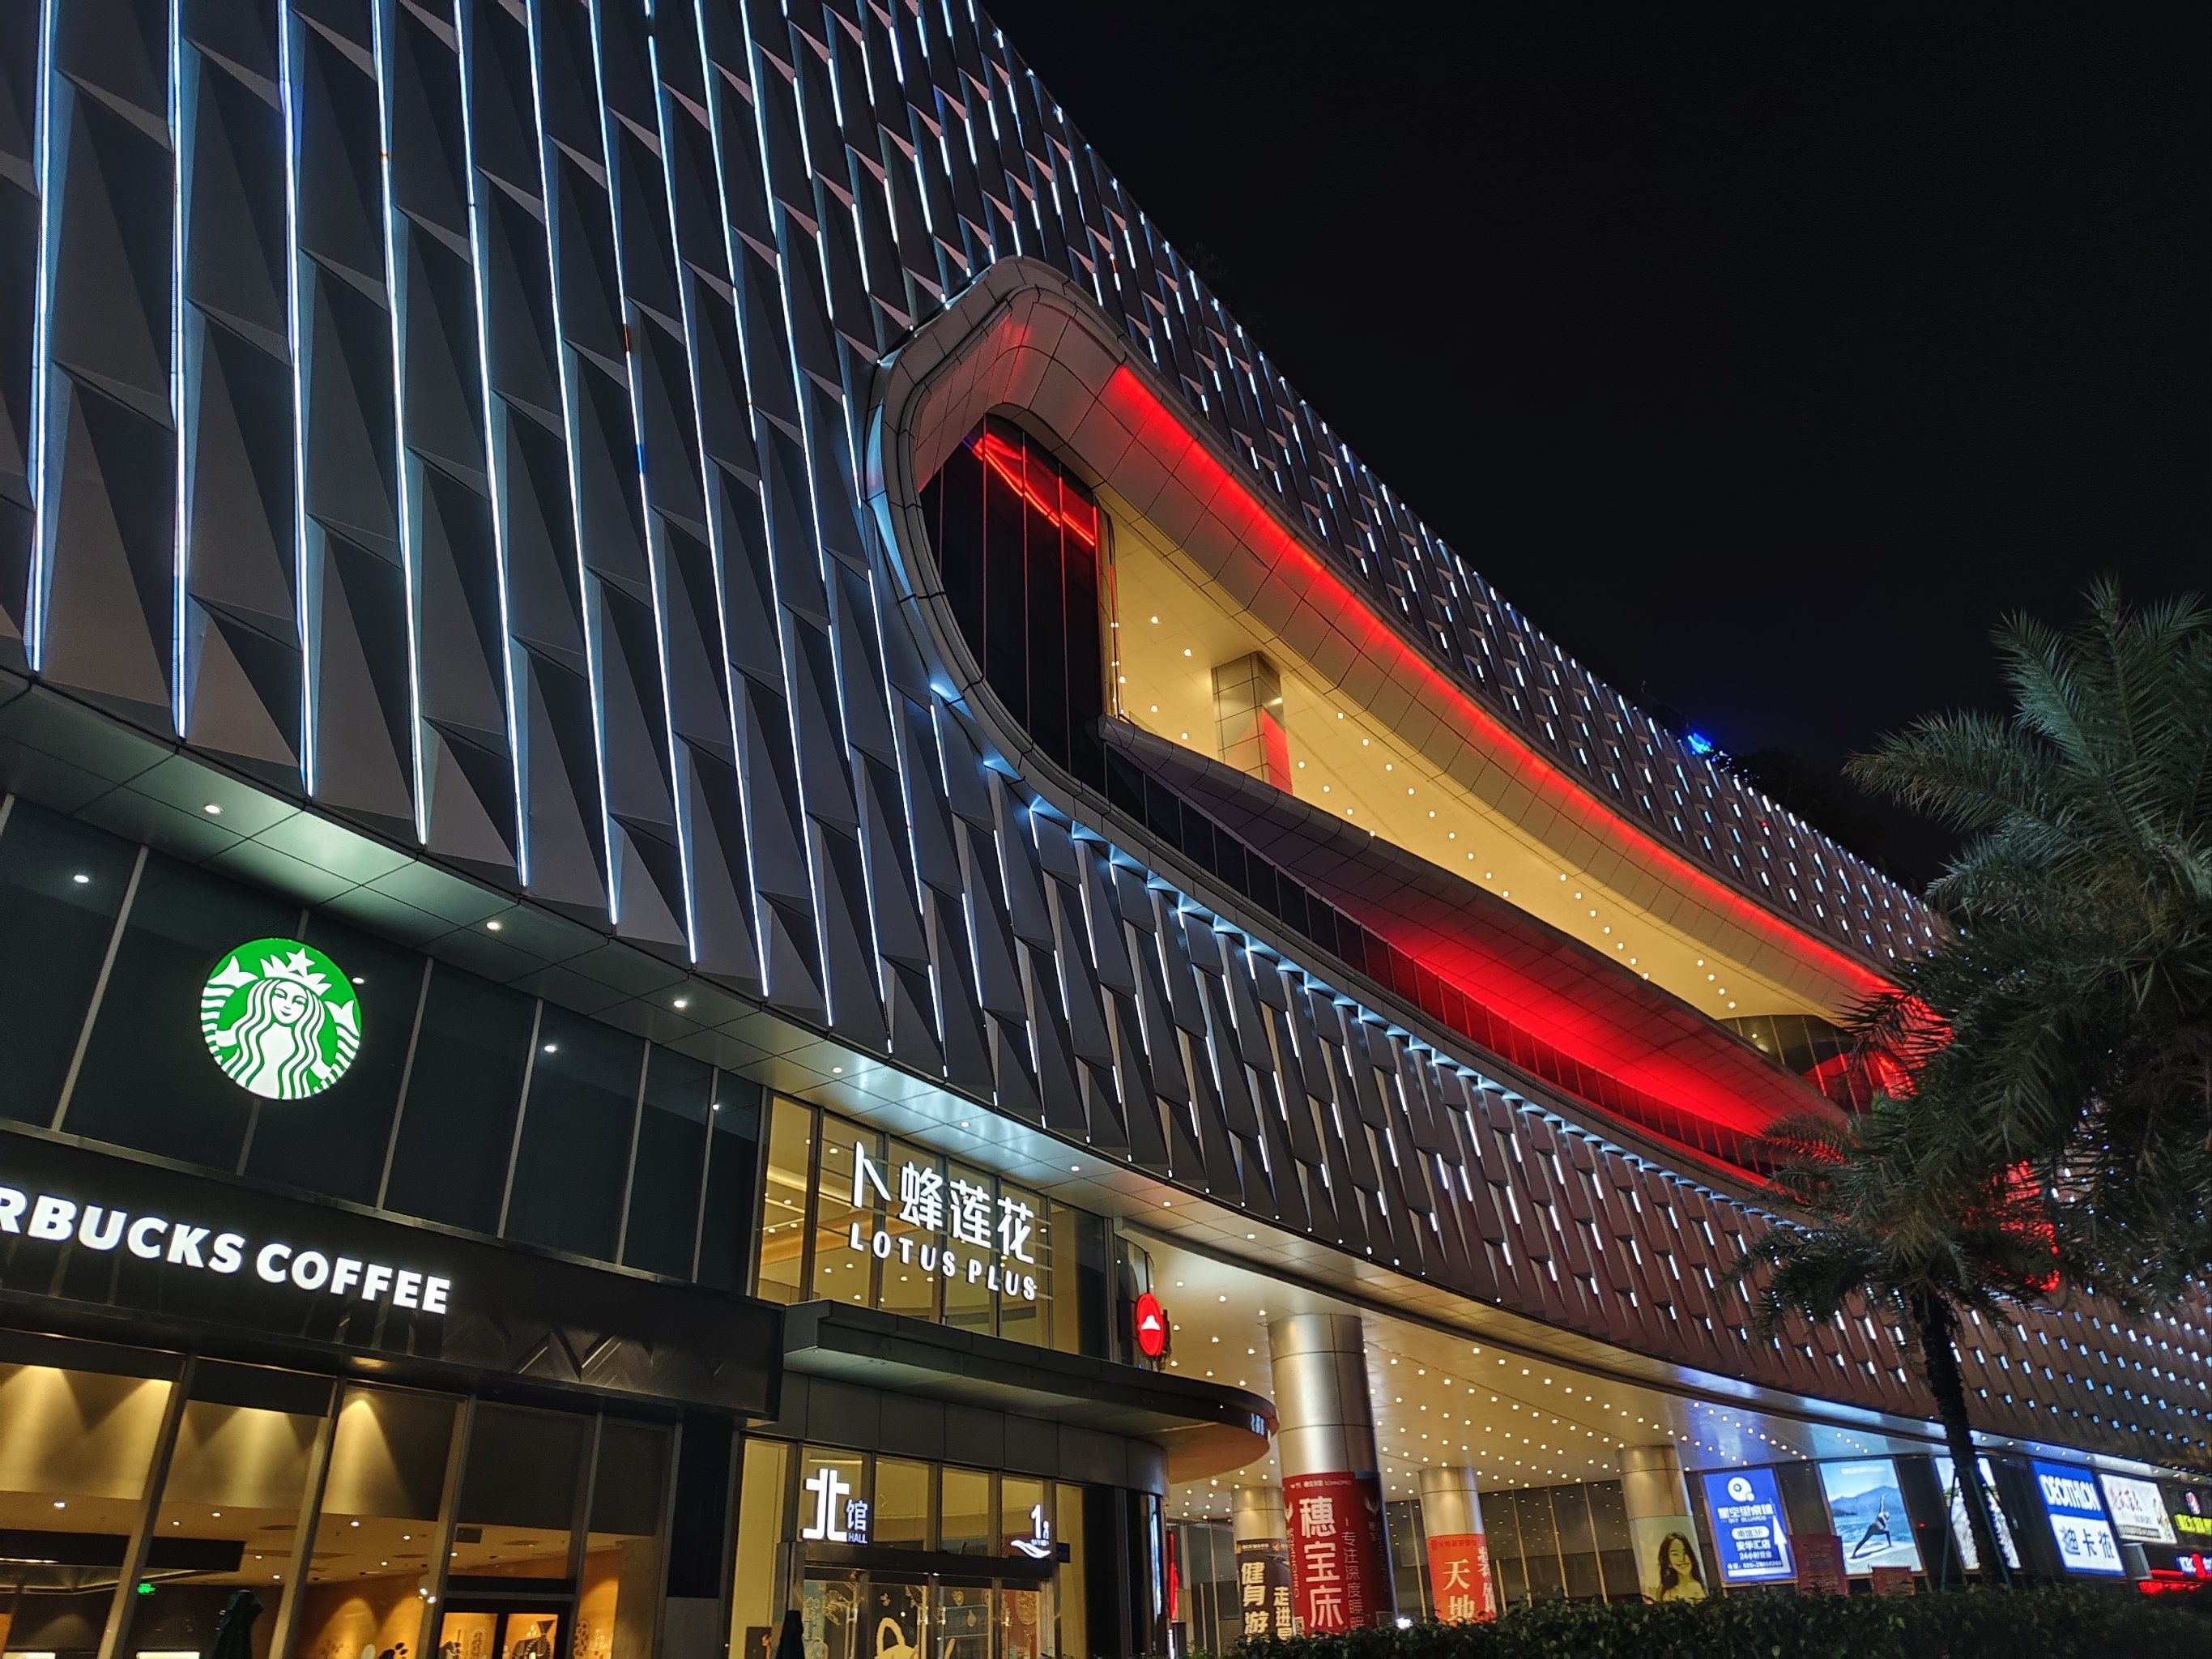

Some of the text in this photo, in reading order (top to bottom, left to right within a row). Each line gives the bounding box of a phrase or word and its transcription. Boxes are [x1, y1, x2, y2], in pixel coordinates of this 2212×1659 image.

[854, 1141, 1034, 1265] 卜蜂莲花
[257, 1243, 451, 1314] COFFEE
[850, 1222, 1035, 1301] LOTUS PLUS
[2039, 1474, 2101, 1512] DECATHLON
[848, 1532, 867, 1543] HALL
[1241, 1562, 1270, 1645] 健身游
